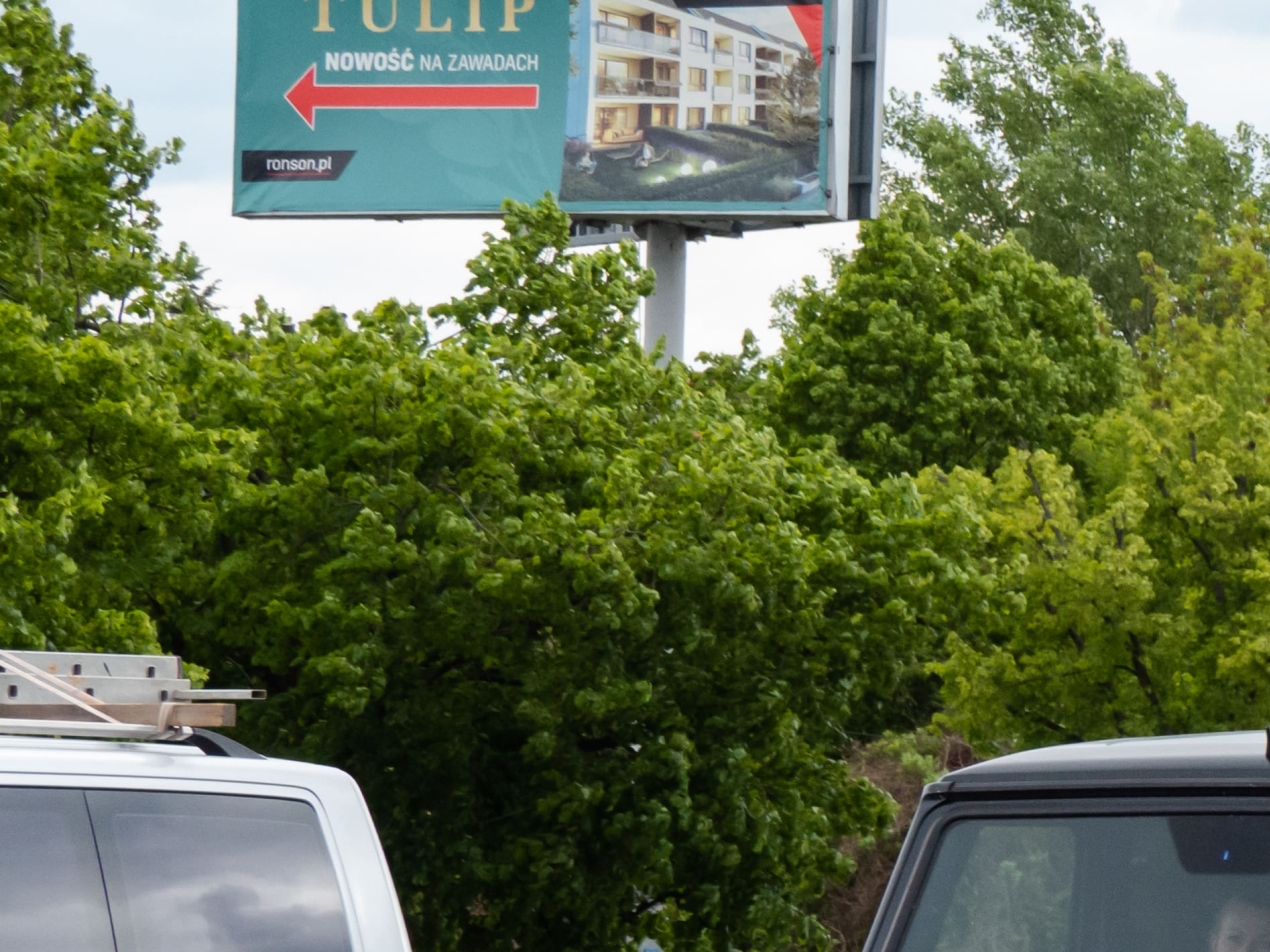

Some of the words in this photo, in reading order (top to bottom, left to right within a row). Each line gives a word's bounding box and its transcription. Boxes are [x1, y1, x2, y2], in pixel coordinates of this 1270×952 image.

[304, 0, 536, 33] TULIP
[325, 47, 414, 72] NOWOŚĆ
[420, 54, 443, 72] NA
[448, 53, 539, 72] ZAWADACH
[266, 156, 332, 173] ronson.pl
